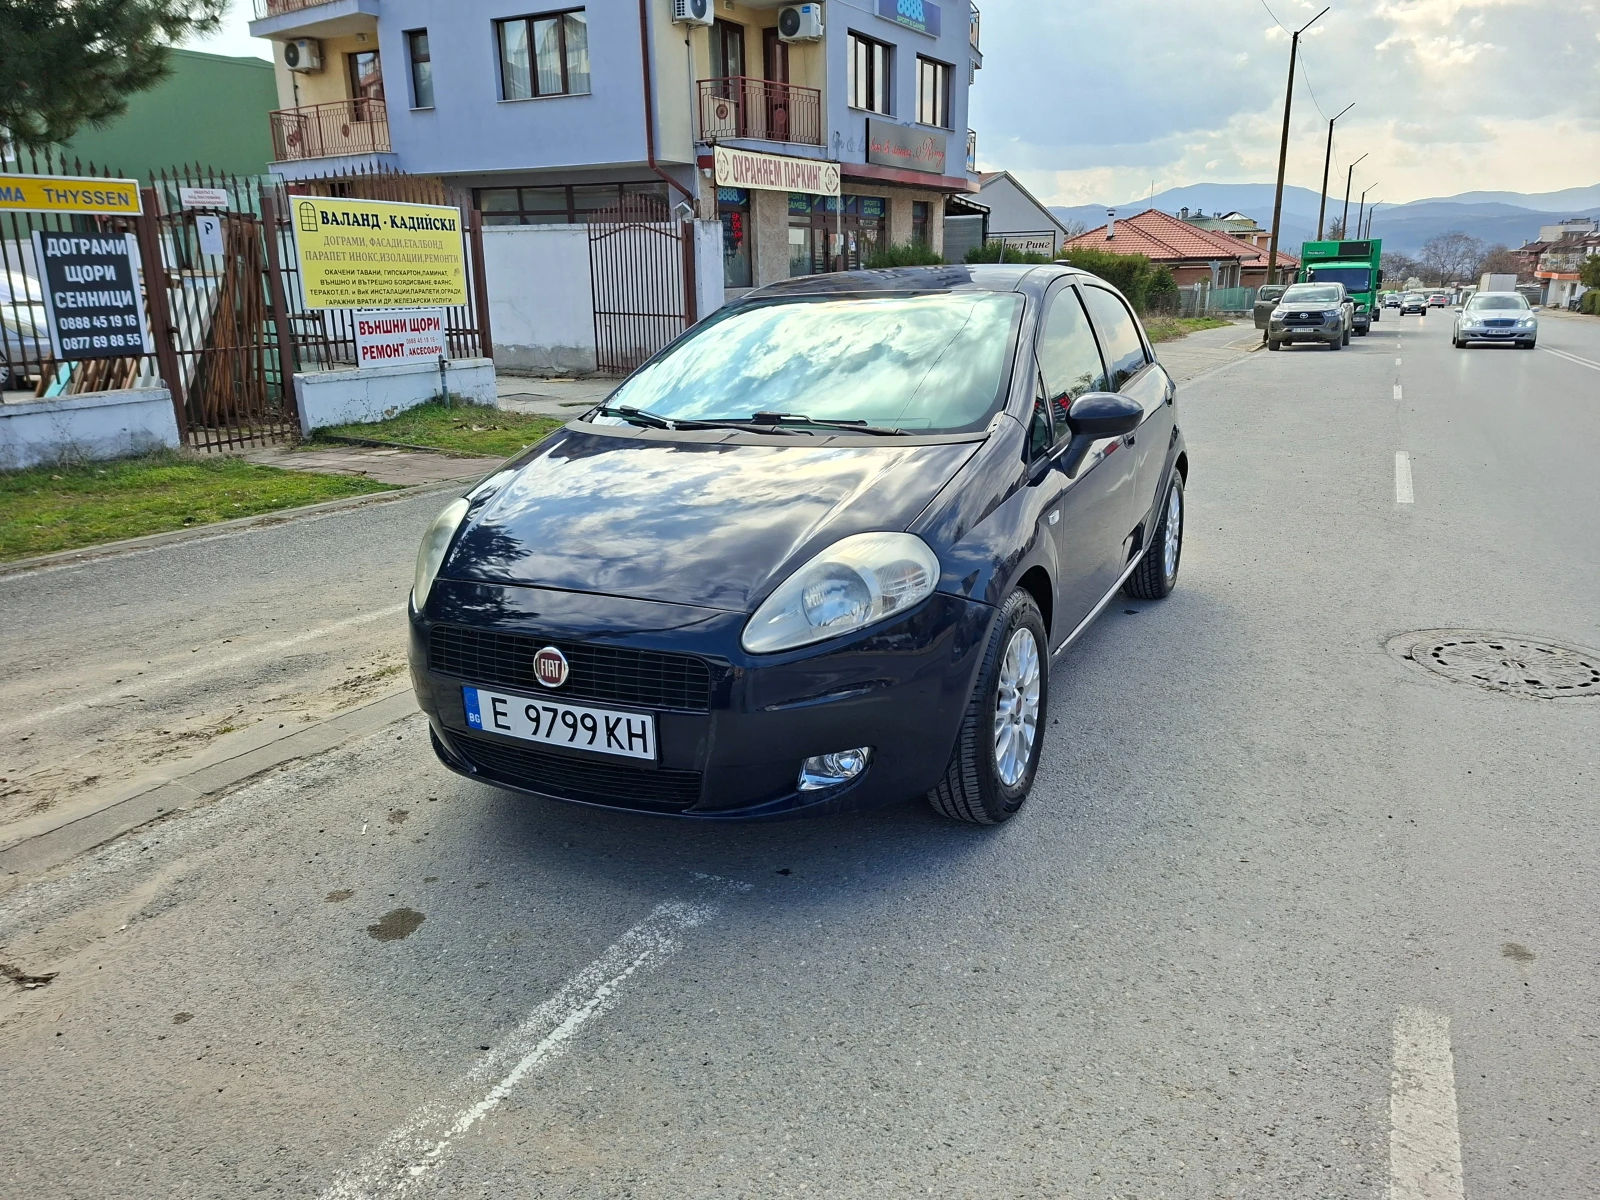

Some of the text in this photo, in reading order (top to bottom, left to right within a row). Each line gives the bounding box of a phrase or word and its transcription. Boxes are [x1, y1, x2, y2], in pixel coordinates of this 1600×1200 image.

[732, 154, 822, 191] ОХРАНЯЕМ ПАРКИНГ
[43, 188, 131, 206] THYSSEN
[864, 207, 880, 215] GAMES
[320, 210, 381, 231] ВАЛАНД
[390, 213, 457, 232] КАДИЙСКИ
[47, 238, 128, 257] ДОГРАМИ
[323, 235, 368, 248] ДОГРАМИ,
[1025, 240, 1051, 249] Ринг
[305, 250, 347, 262] ПАРАПЕТ
[64, 265, 117, 284] ЩОРИ
[324, 268, 356, 276] ОКАЧЕНИ
[54, 290, 134, 309] СЕННИЦИ
[325, 298, 356, 306] ГАРАЖНИ
[393, 297, 431, 305] ЖЕЛЕЗАРСКИ
[59, 314, 137, 330] 0888 45 19 16
[358, 317, 441, 336] ВЪНШНИ ЩОРИ
[62, 333, 141, 351] 0877 69 88 55
[361, 343, 443, 360] РЕМОНТ АКСЕСОАРИ
[540, 658, 560, 678] FIAT
[468, 712, 481, 724] BG
[491, 696, 512, 731] E
